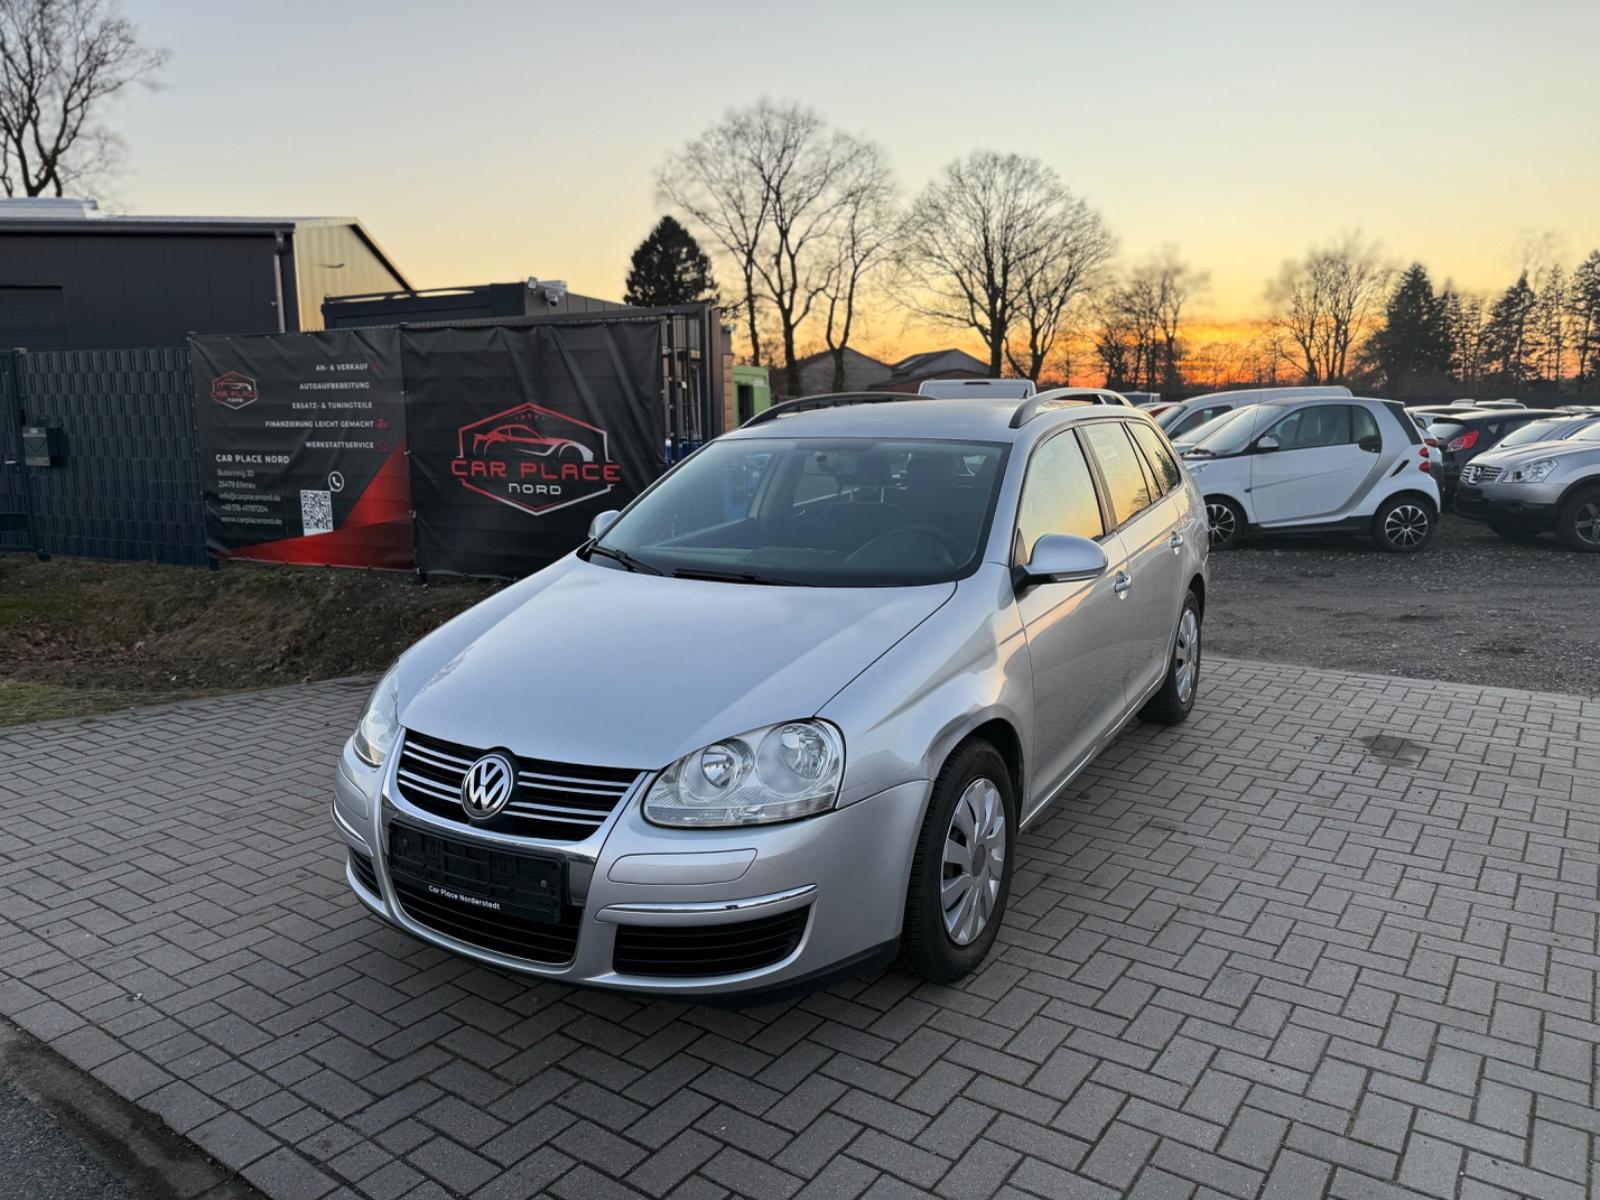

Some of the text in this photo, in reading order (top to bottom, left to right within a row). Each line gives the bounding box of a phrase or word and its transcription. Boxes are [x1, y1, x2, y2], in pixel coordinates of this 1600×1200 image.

[315, 362, 368, 372] AN- & VERKAUF
[299, 382, 370, 390] AUTOAUFBEREITUNG
[291, 402, 320, 410] ERSATZ-
[328, 401, 373, 409] TUNINGTEILE
[265, 420, 374, 428] FINANZIERUNG LEICHT GEMACHT
[305, 441, 374, 449] WERKSTATTSERVICE
[216, 454, 290, 465] CAR PLACE NORD
[451, 460, 621, 481] CAR PLACE
[428, 884, 501, 911] Car Place Norderstedt
